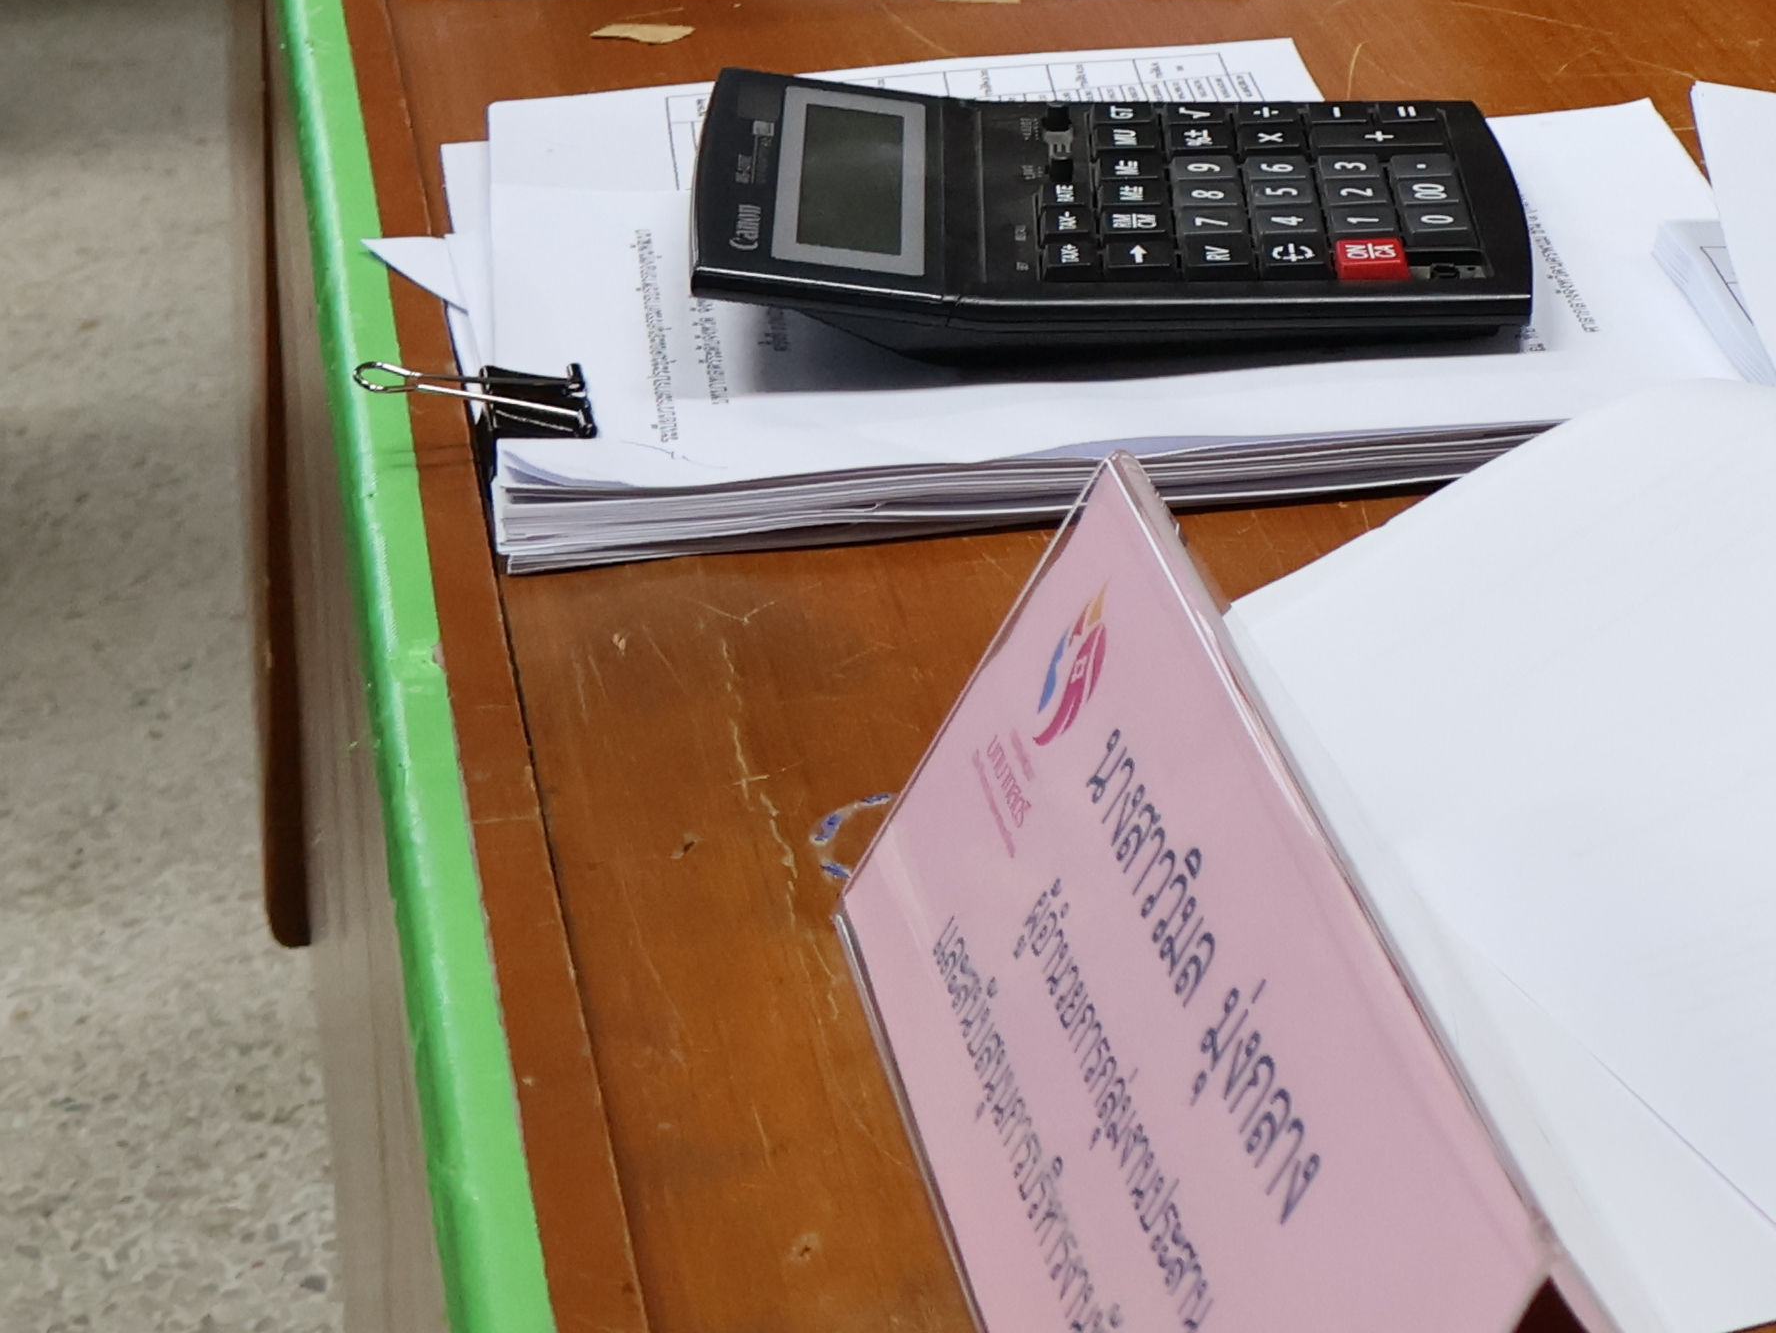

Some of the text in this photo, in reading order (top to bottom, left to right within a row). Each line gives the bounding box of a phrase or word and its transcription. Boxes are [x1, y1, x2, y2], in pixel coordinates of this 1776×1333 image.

[1187, 162, 1221, 173] 9
[1260, 162, 1293, 173] 6
[1334, 161, 1367, 171] 3
[1191, 189, 1225, 200] 8
[1265, 187, 1298, 196] 5
[1340, 187, 1373, 197] 2
[1412, 183, 1447, 200] 00
[1194, 216, 1229, 227] 7
[1270, 216, 1303, 226] 4
[1347, 216, 1379, 224] 1
[1420, 214, 1454, 224] 0
[728, 204, 761, 251] Canon
[1204, 245, 1231, 261] RV
